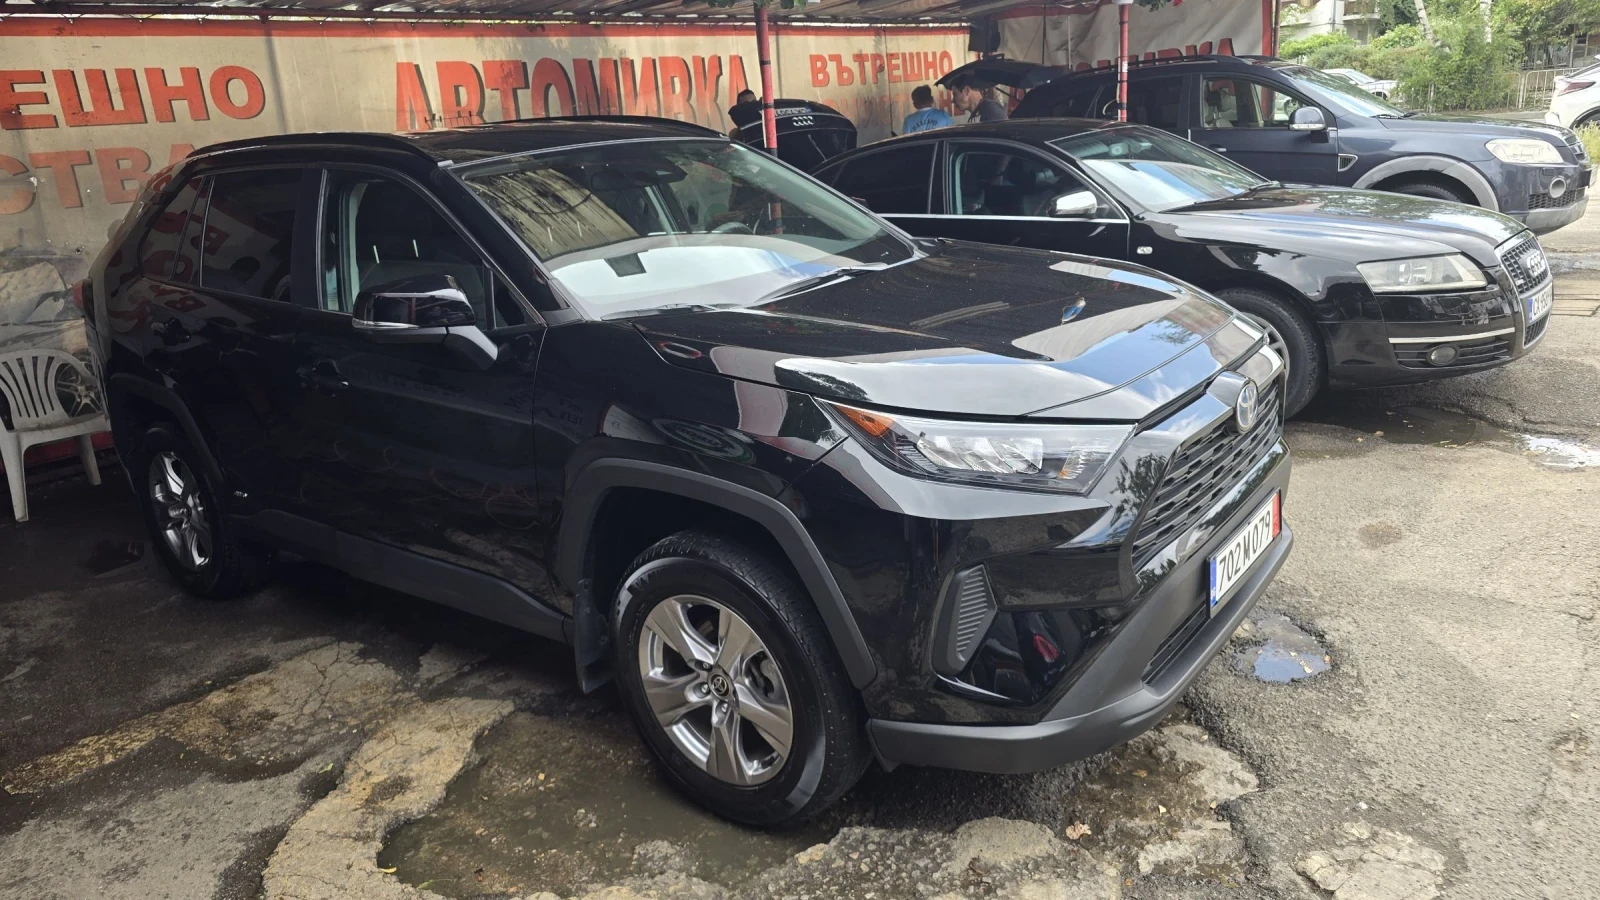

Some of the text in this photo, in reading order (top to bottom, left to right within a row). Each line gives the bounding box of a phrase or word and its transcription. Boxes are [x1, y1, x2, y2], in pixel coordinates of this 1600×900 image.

[0, 65, 266, 131] ЕШНО
[808, 50, 954, 88] ВЪТРЕШНО
[0, 143, 195, 216] СТВ
